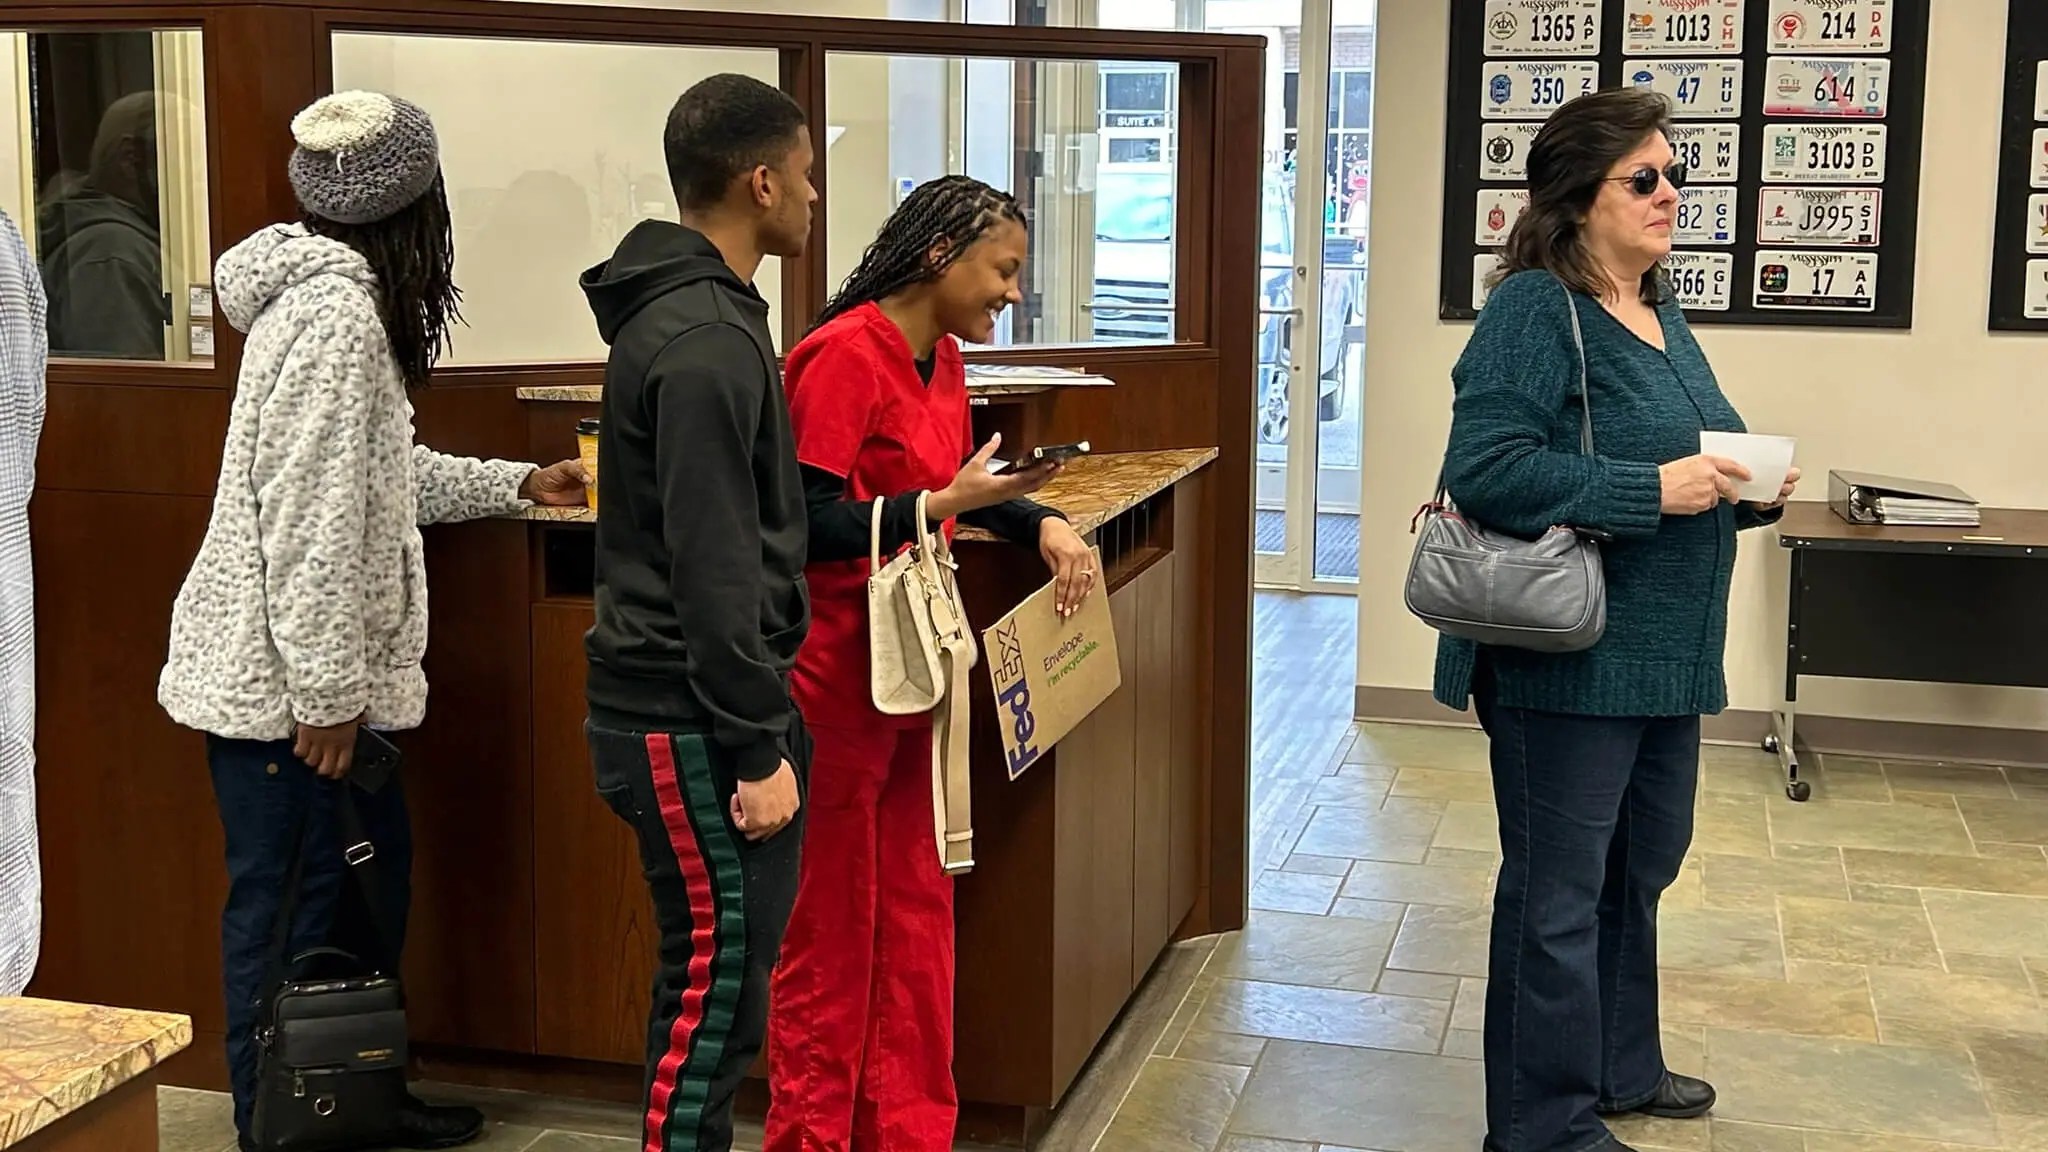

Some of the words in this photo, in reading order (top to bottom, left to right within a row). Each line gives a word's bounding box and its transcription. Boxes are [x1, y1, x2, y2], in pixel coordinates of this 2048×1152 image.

[1531, 14, 1575, 41] 1365
[1665, 14, 1710, 41] 1013
[1821, 12, 1856, 39] 214
[1531, 78, 1564, 104] 350
[1677, 78, 1700, 104] 47
[1814, 76, 1854, 102] 614
[1118, 116, 1145, 126] SUITE
[1147, 116, 1155, 126] A
[1808, 142, 1854, 169] 3103
[1799, 205, 1854, 231] J995
[1812, 269, 1834, 295] 17
[1044, 630, 1084, 673] Envelope
